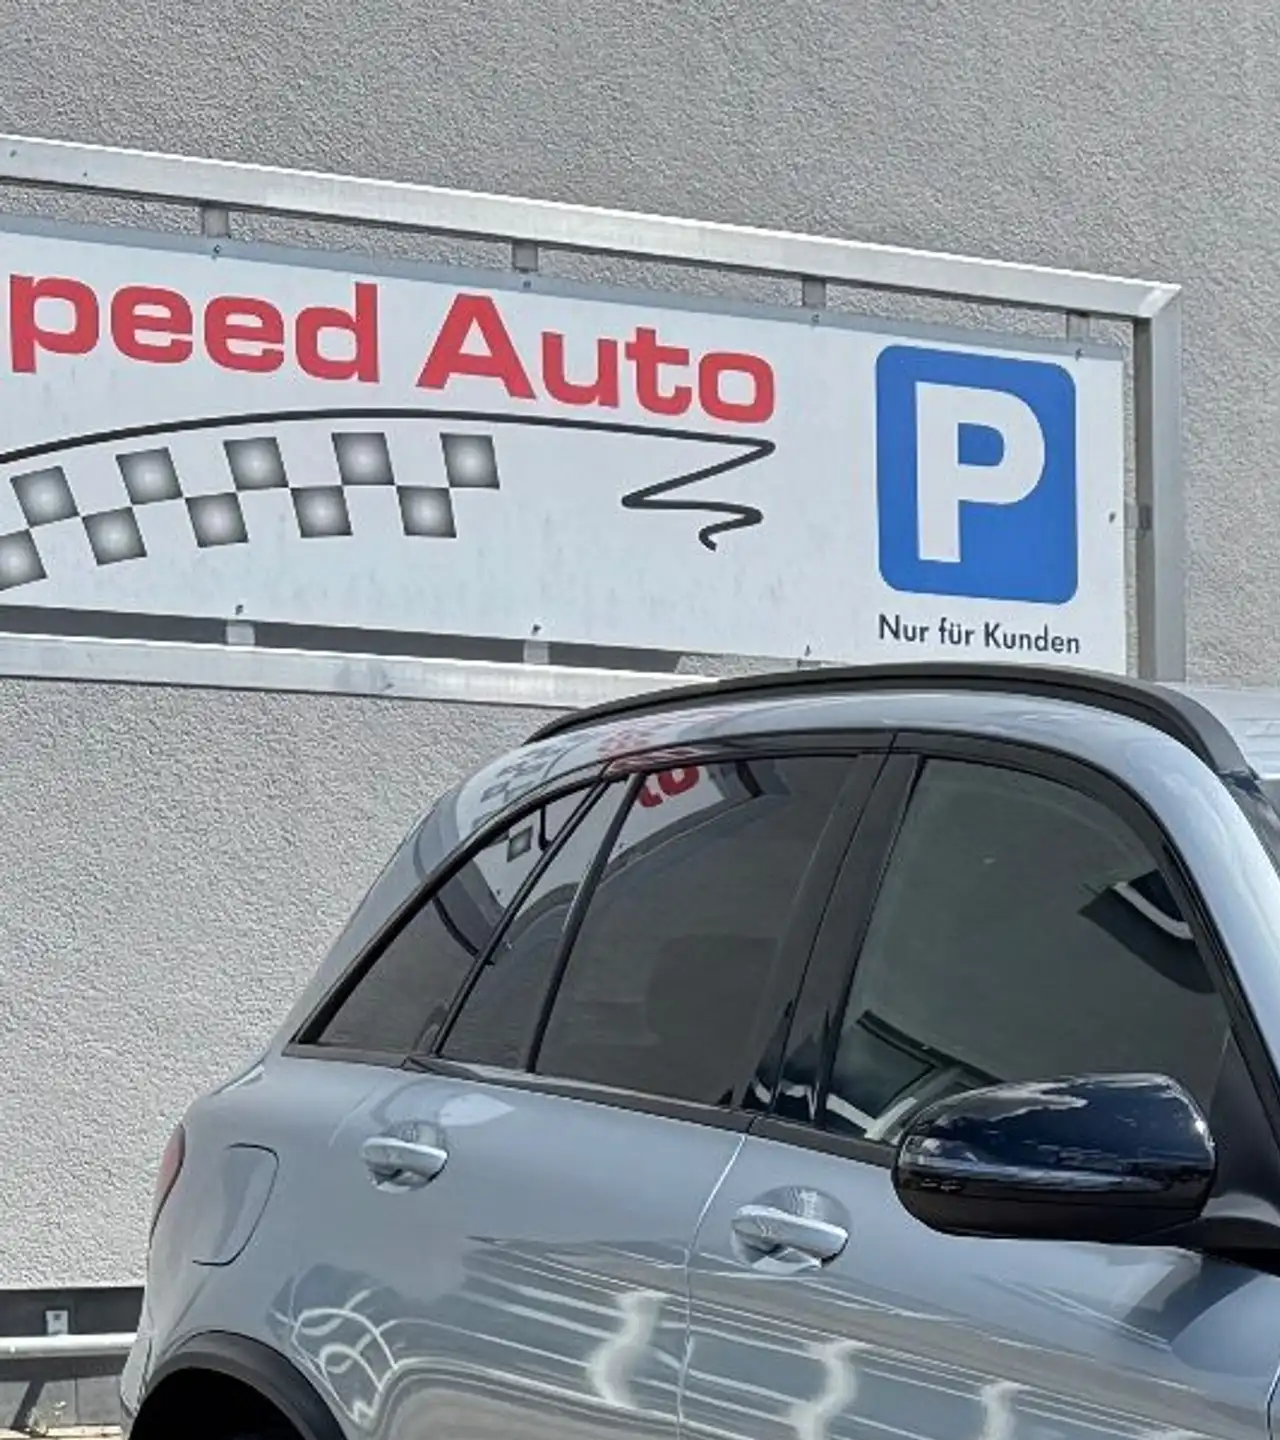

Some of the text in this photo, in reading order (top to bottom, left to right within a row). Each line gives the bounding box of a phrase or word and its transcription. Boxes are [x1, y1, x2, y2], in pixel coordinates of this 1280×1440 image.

[416, 294, 776, 423] Auto
[915, 380, 1046, 564] P
[878, 613, 1081, 654] Nur für Kunden
